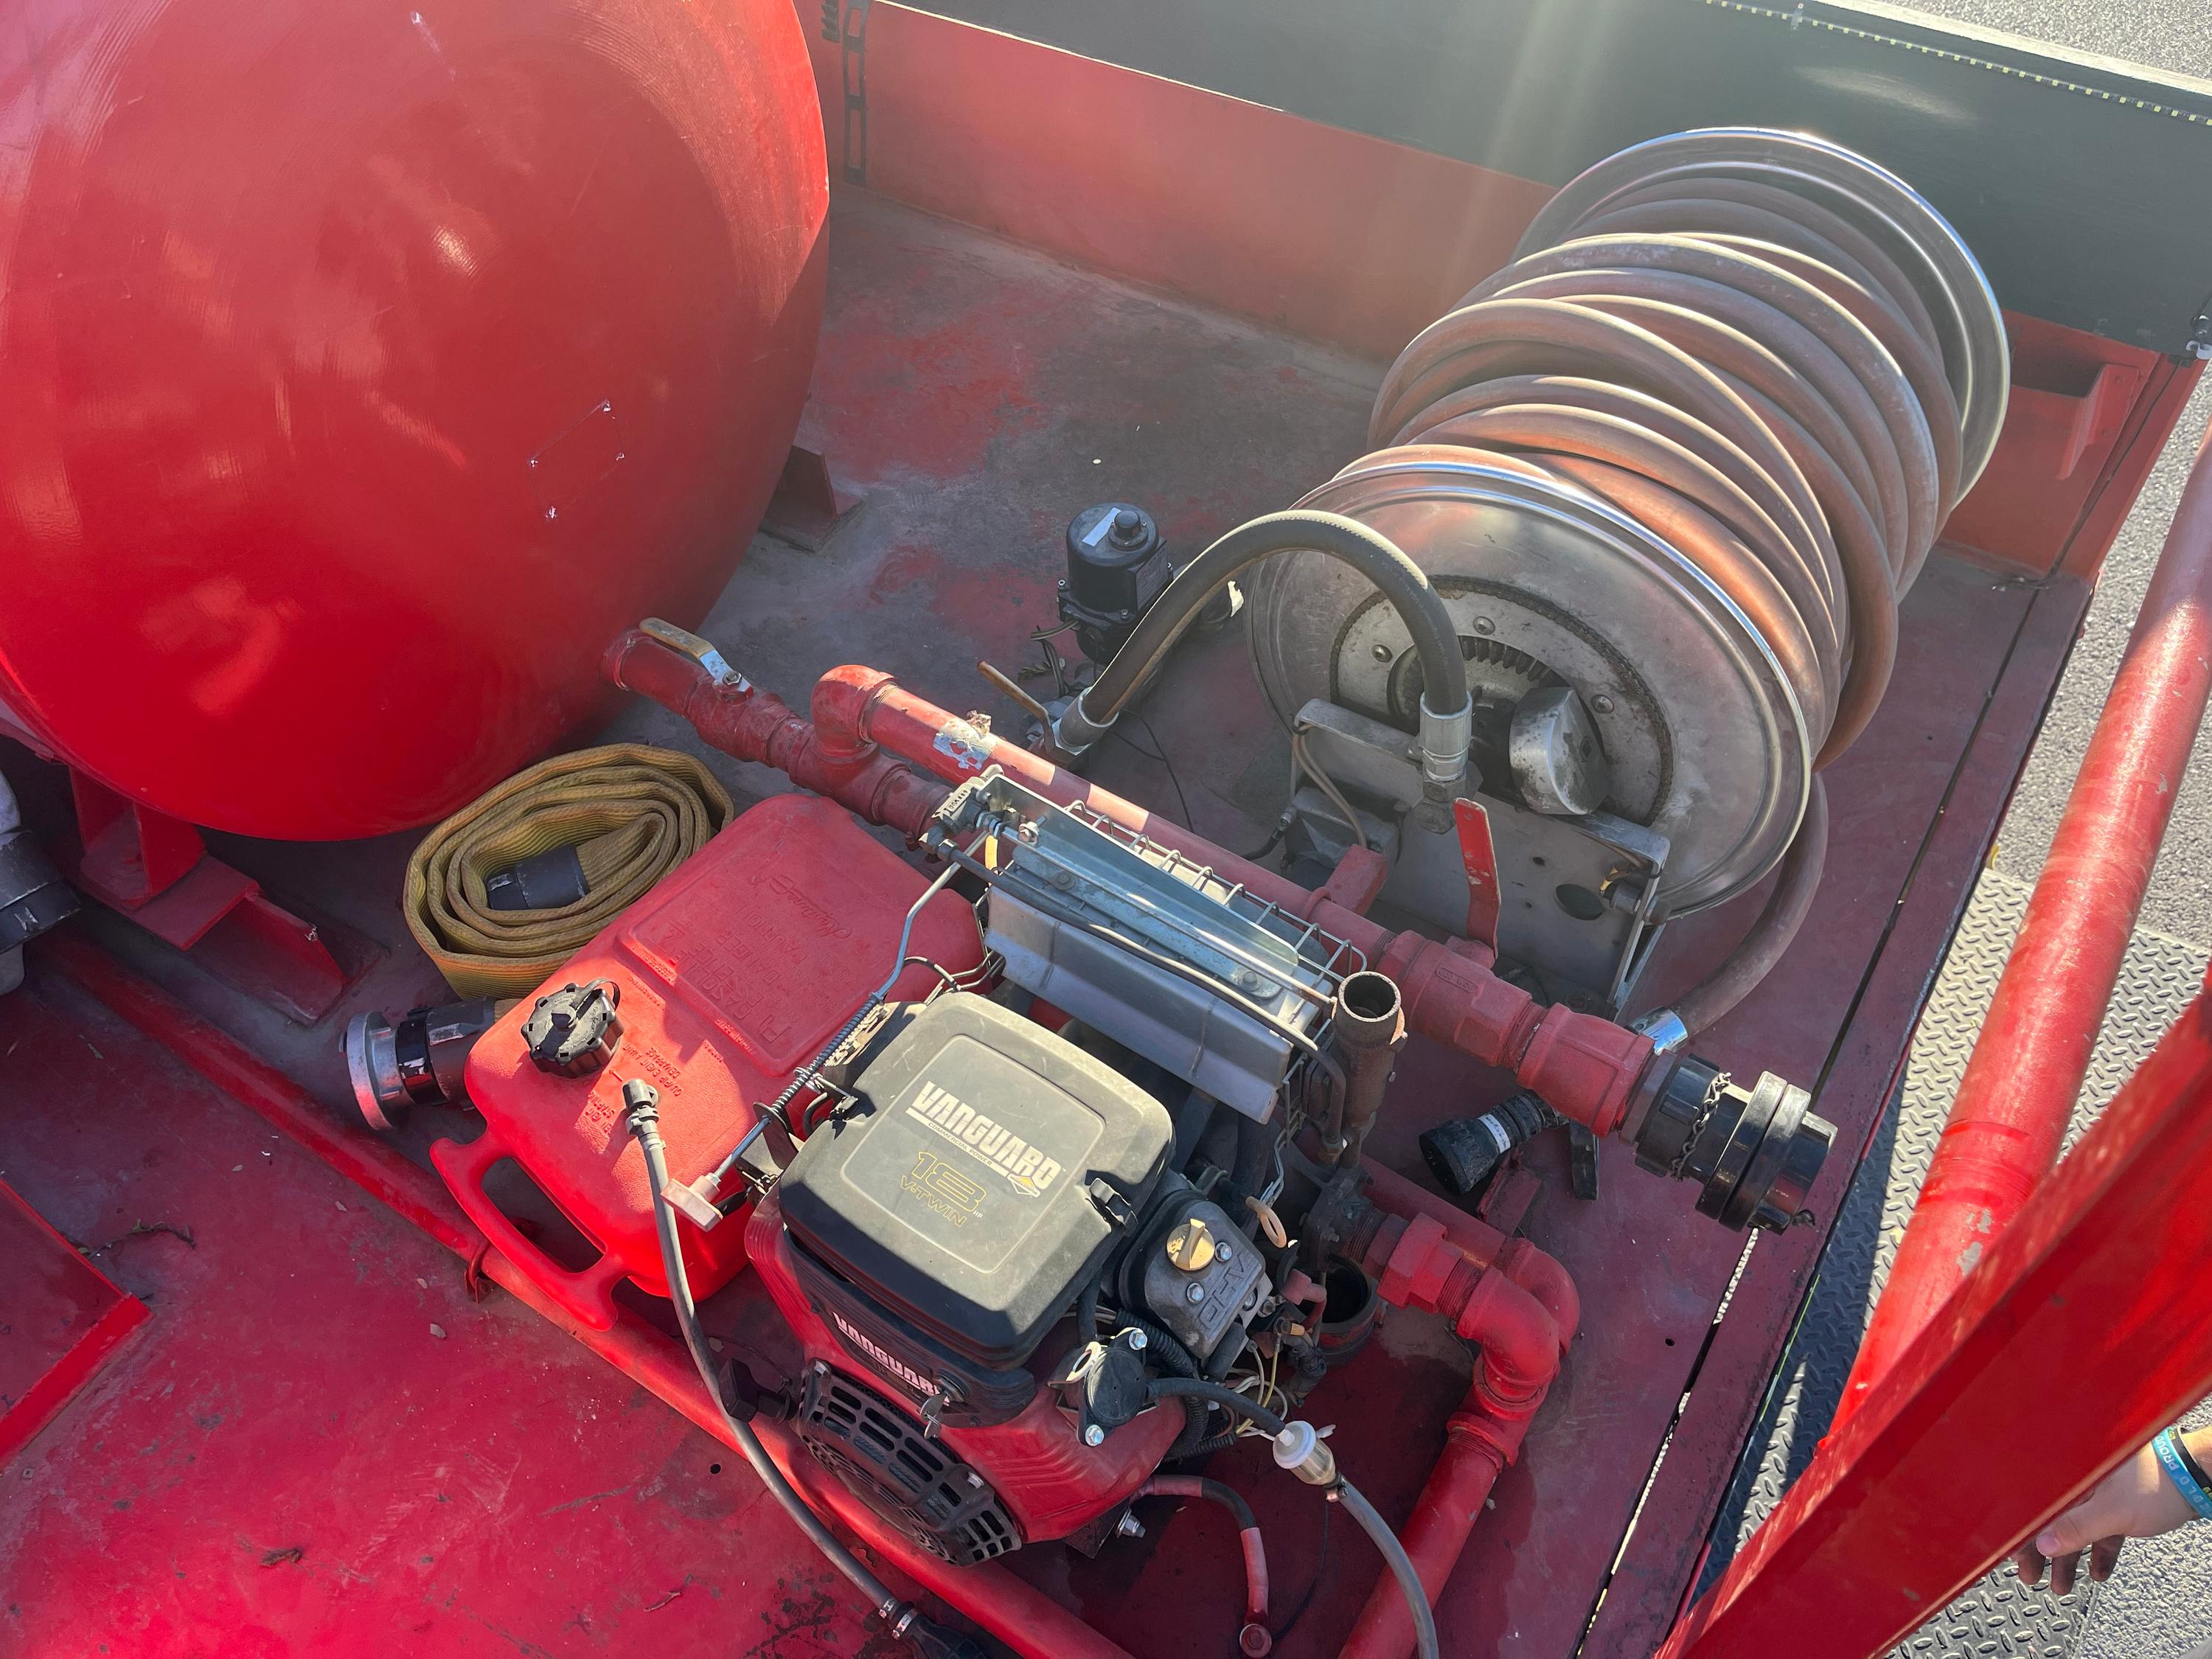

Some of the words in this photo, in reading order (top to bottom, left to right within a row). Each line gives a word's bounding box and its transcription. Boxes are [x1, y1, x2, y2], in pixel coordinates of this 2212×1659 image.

[713, 926, 781, 987] DANGER
[734, 901, 808, 967] CAUTION
[669, 947, 753, 1022] GASOLINE
[686, 939, 765, 1009] ESSENCE
[911, 1081, 1062, 1190] VANGUARD
[928, 1121, 968, 1153] COMMERCIAL
[969, 1149, 992, 1166] POWER
[900, 1175, 967, 1228] V-TWIN
[911, 1152, 987, 1212] 18
[972, 1210, 984, 1219] HP
[1194, 1252, 1254, 1329] OHV
[2154, 1434, 2180, 1472] PROUD
